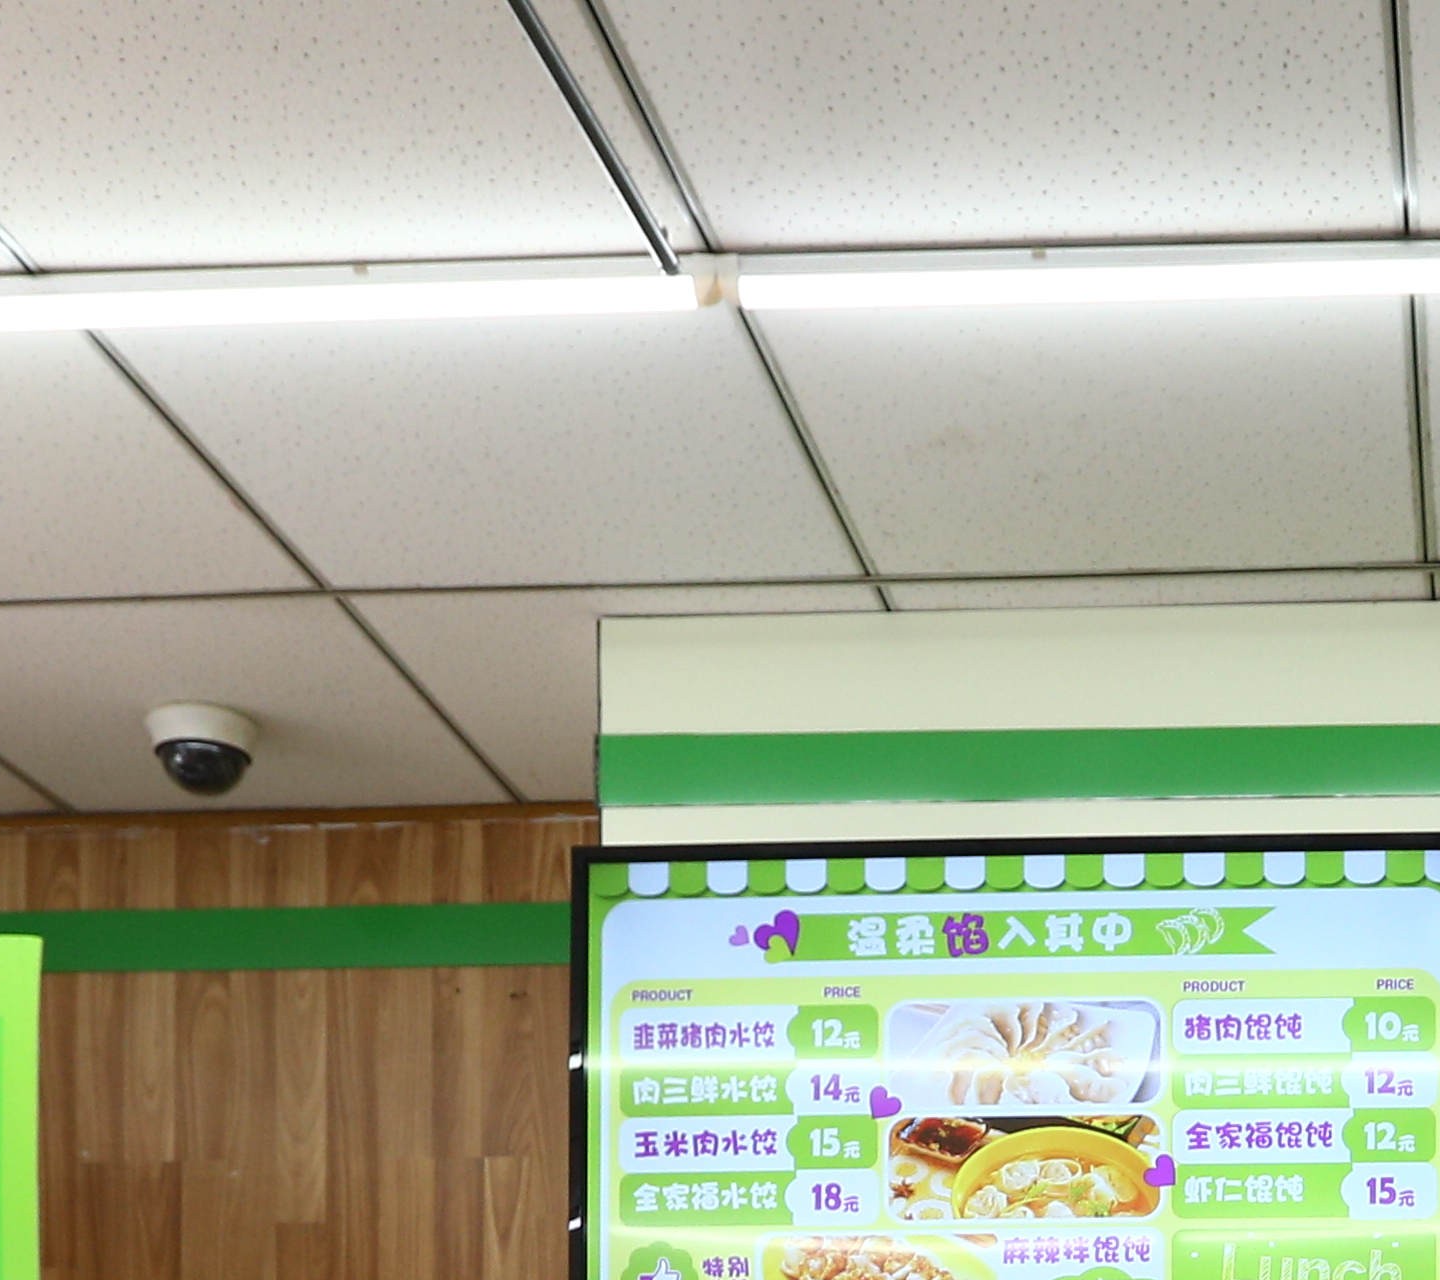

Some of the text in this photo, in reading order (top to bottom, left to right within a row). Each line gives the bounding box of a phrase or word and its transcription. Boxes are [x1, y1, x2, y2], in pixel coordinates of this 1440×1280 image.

[846, 911, 1133, 958] 温柔馅入其中
[632, 986, 861, 1001] PRODUCT PRICE
[1183, 979, 1415, 993] PRODUCT PRICE
[632, 1018, 860, 1051] 韭菜猪肉水饺 12元
[1184, 1012, 1420, 1043] 猪肉馄饨 10元
[632, 1073, 861, 1105] 肉三鲜水饺 14元
[1184, 1068, 1414, 1097] 肉三鲜馄饨 12元
[633, 1127, 861, 1159] 玉米肉水饺 15元
[1185, 1120, 1416, 1153] 全家福馄饨 12元
[633, 1182, 860, 1213] 全家福水饺 18元
[1184, 1175, 1415, 1208] 虾仁馄饨 15元
[702, 1255, 750, 1278] 特别
[1001, 1236, 1151, 1266] 麻辣拌馄饨
